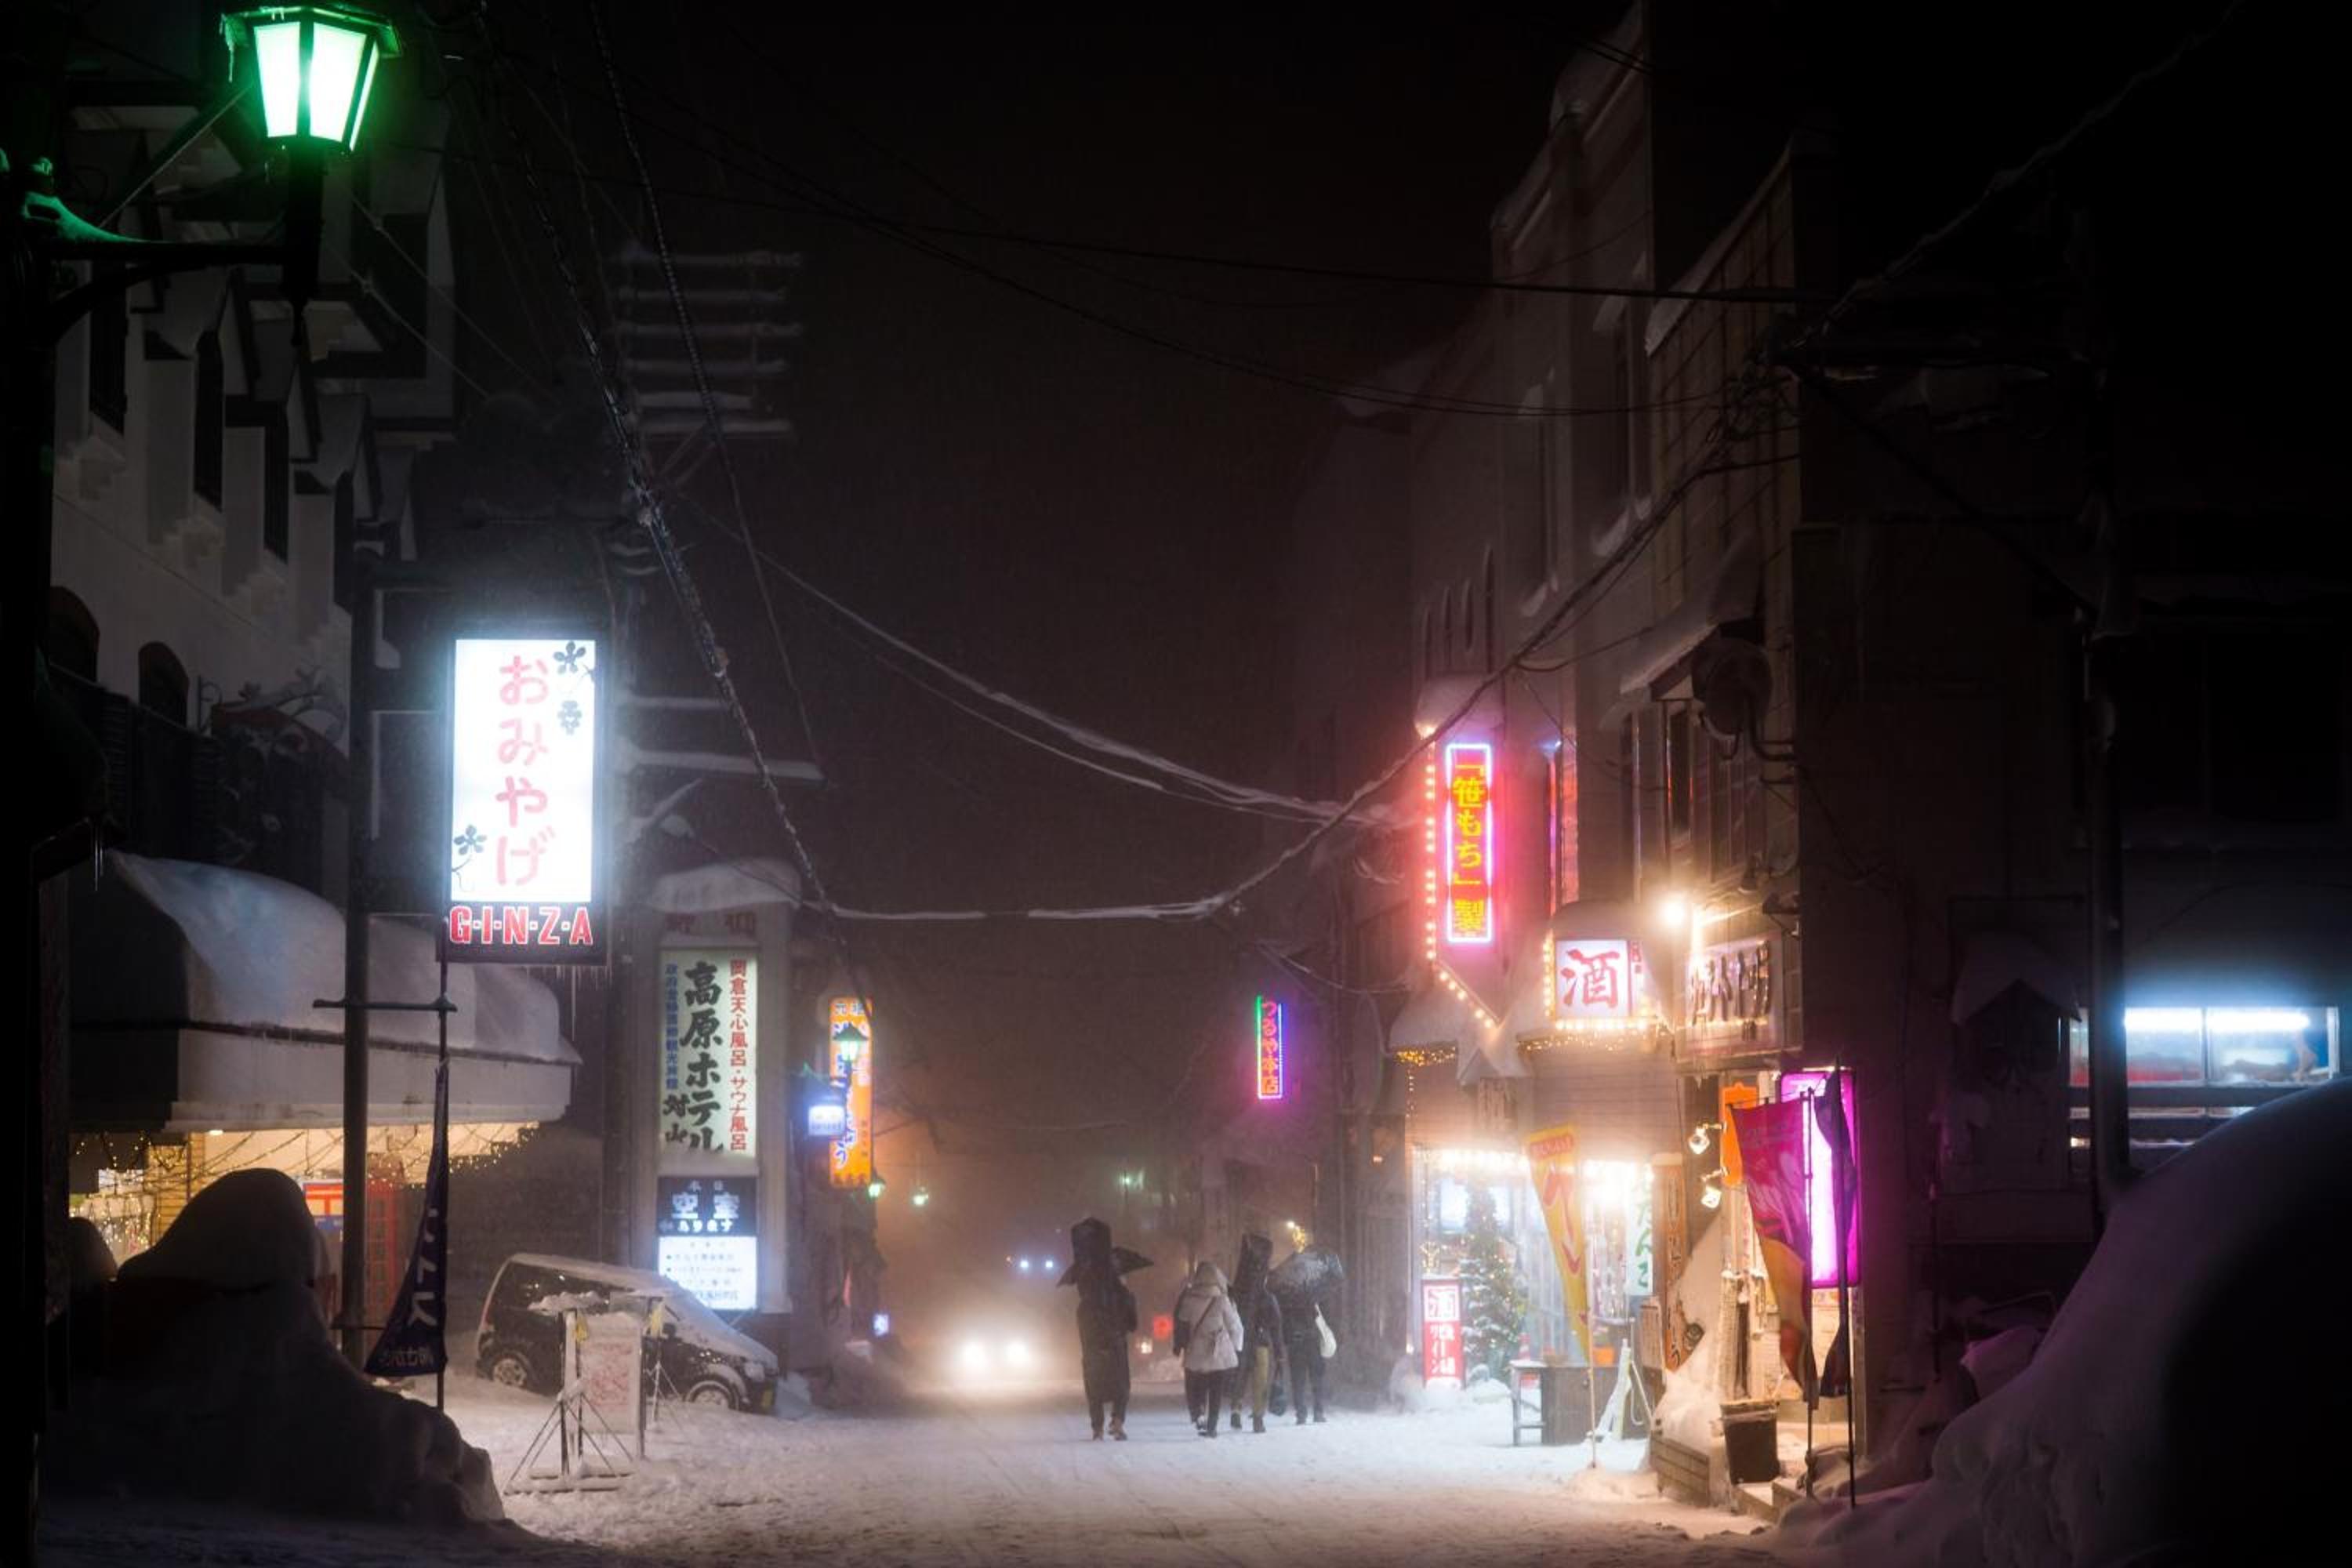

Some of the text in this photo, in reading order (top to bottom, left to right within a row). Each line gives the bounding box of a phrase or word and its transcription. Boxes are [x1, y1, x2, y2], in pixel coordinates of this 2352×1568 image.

[495, 655, 556, 886] おみやげ
[679, 960, 724, 1153] 高原ホテル
[1560, 948, 1621, 1009] 酒
